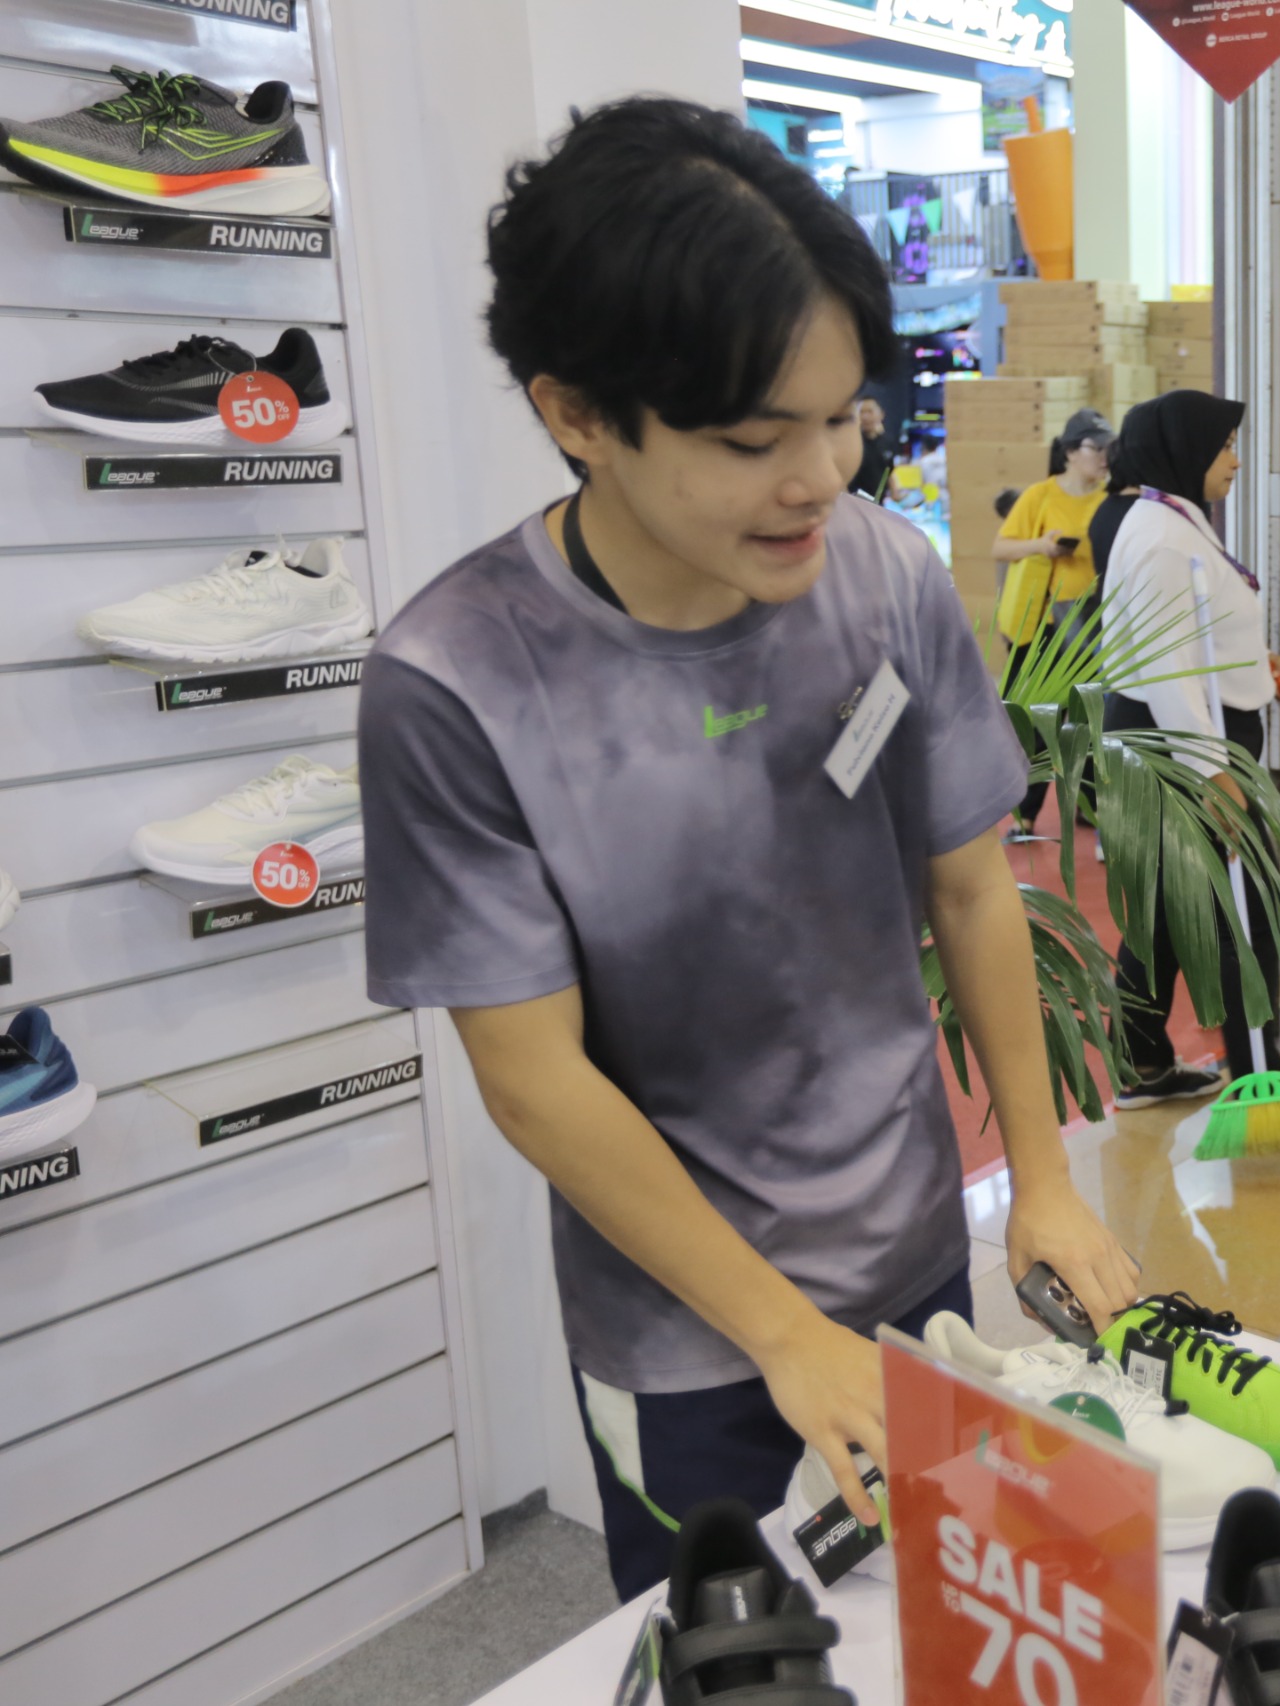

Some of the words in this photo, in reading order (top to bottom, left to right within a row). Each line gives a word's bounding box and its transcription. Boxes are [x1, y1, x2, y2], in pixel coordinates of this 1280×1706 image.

[168, 0, 288, 23] NNING
[81, 214, 139, 239] League
[210, 225, 323, 252] RUNNING
[100, 463, 156, 484] League
[224, 460, 334, 481] RUNNING
[286, 661, 363, 689] RUNNI
[315, 881, 365, 907] RUN
[321, 1060, 416, 1104] RUNNING
[938, 1514, 1104, 1663] SALE
[959, 1591, 1078, 1706] 70
